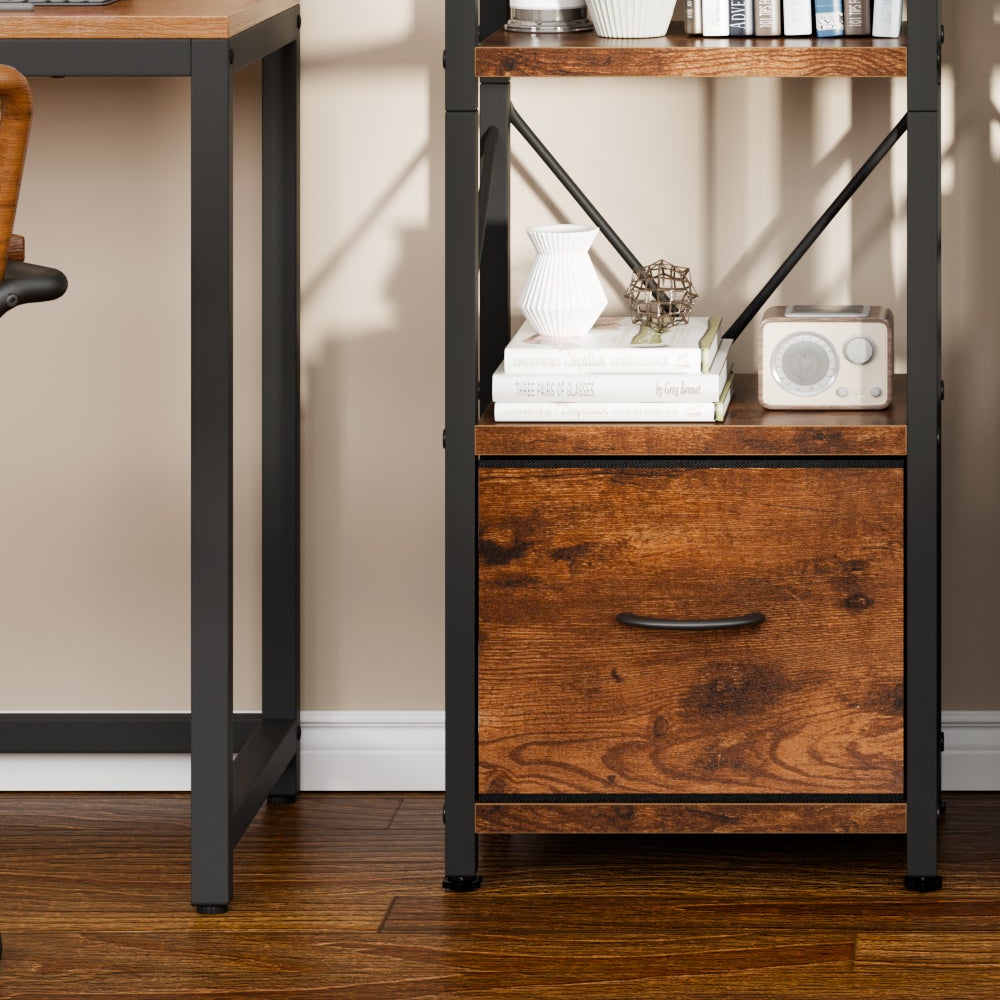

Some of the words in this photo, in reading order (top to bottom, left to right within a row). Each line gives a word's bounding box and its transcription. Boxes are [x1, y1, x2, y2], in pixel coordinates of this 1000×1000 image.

[849, 4, 862, 16] TIPS
[849, 17, 862, 27] 101
[515, 382, 535, 396] THREE
[537, 382, 555, 396] PAIRS
[557, 382, 565, 396] OF
[567, 382, 596, 396] GLASSES
